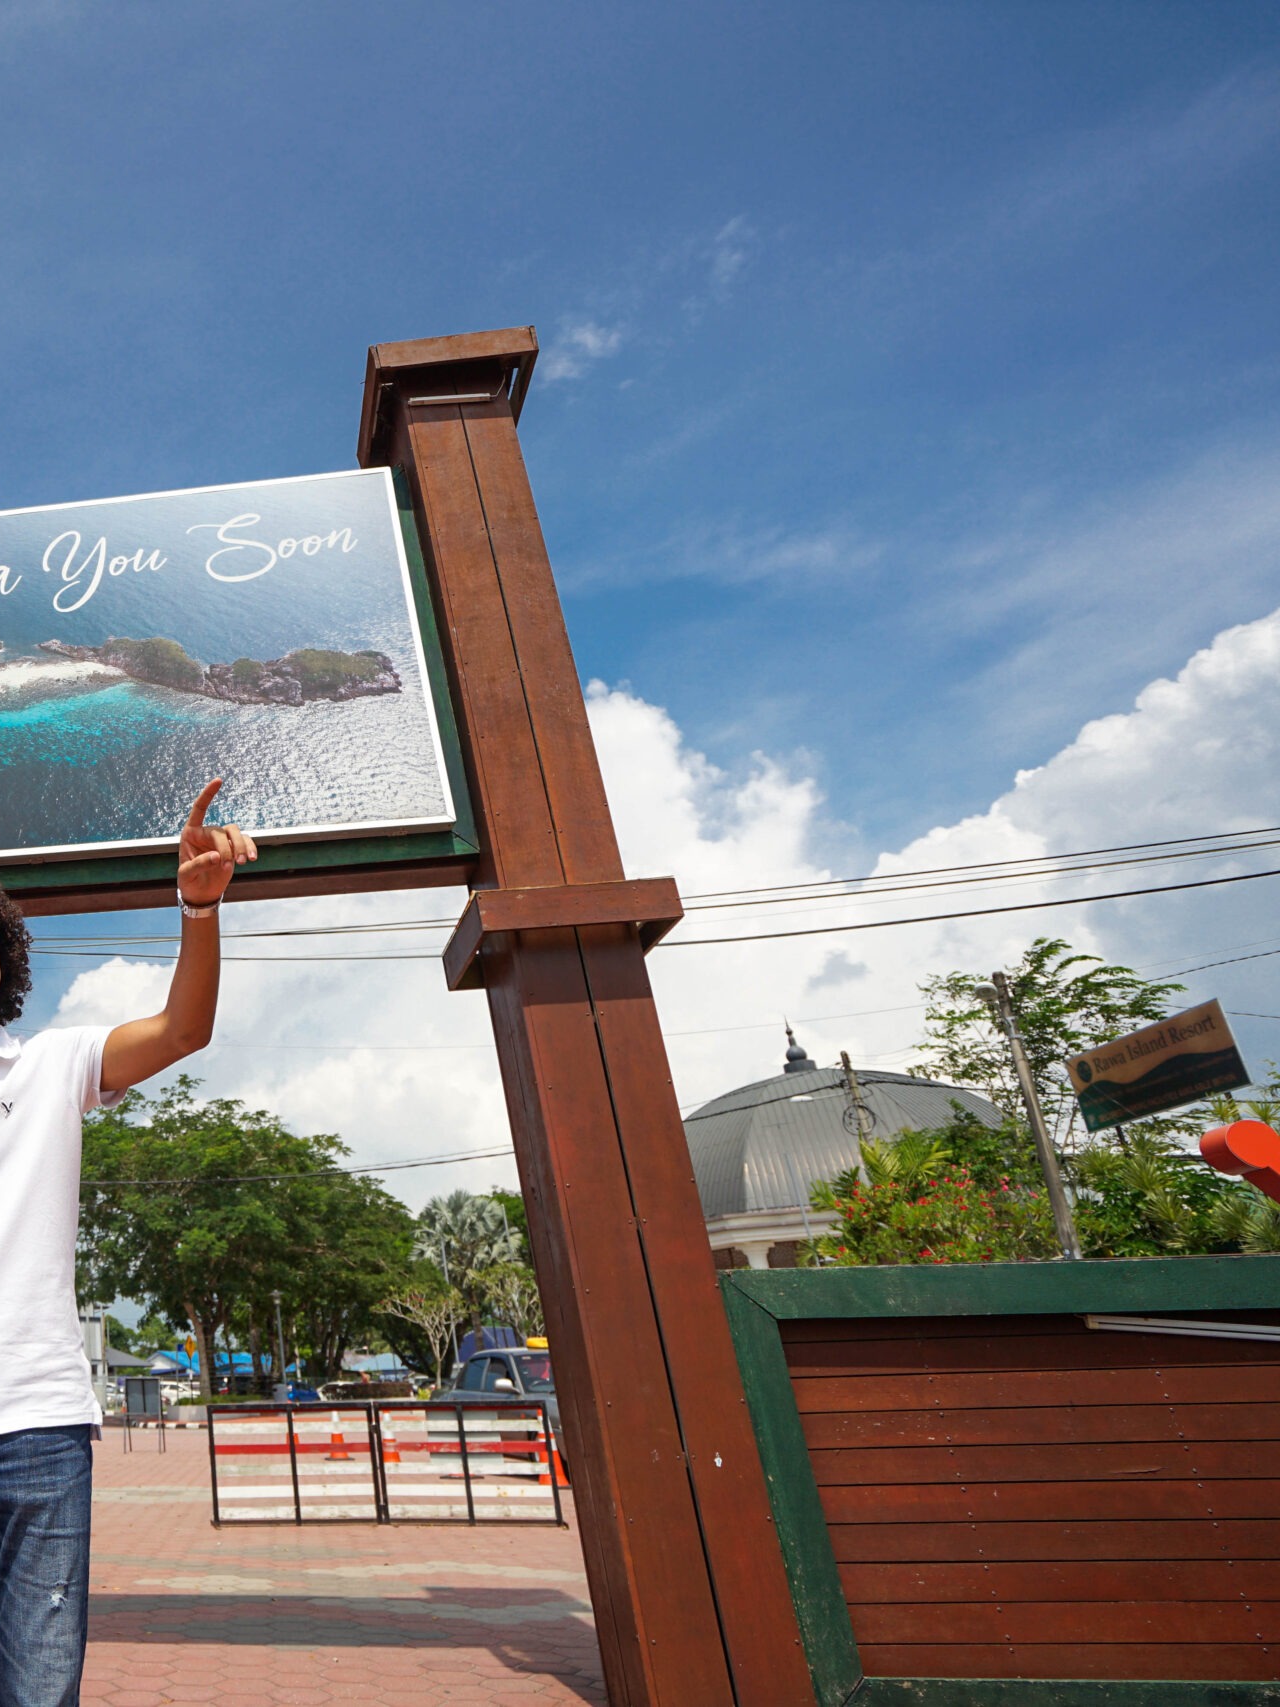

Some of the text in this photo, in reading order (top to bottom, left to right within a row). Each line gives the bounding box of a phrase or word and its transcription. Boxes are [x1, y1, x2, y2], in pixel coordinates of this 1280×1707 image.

[42, 530, 167, 613] You
[185, 513, 358, 583] Soon
[1092, 1013, 1217, 1074] Rawa Island Resort
